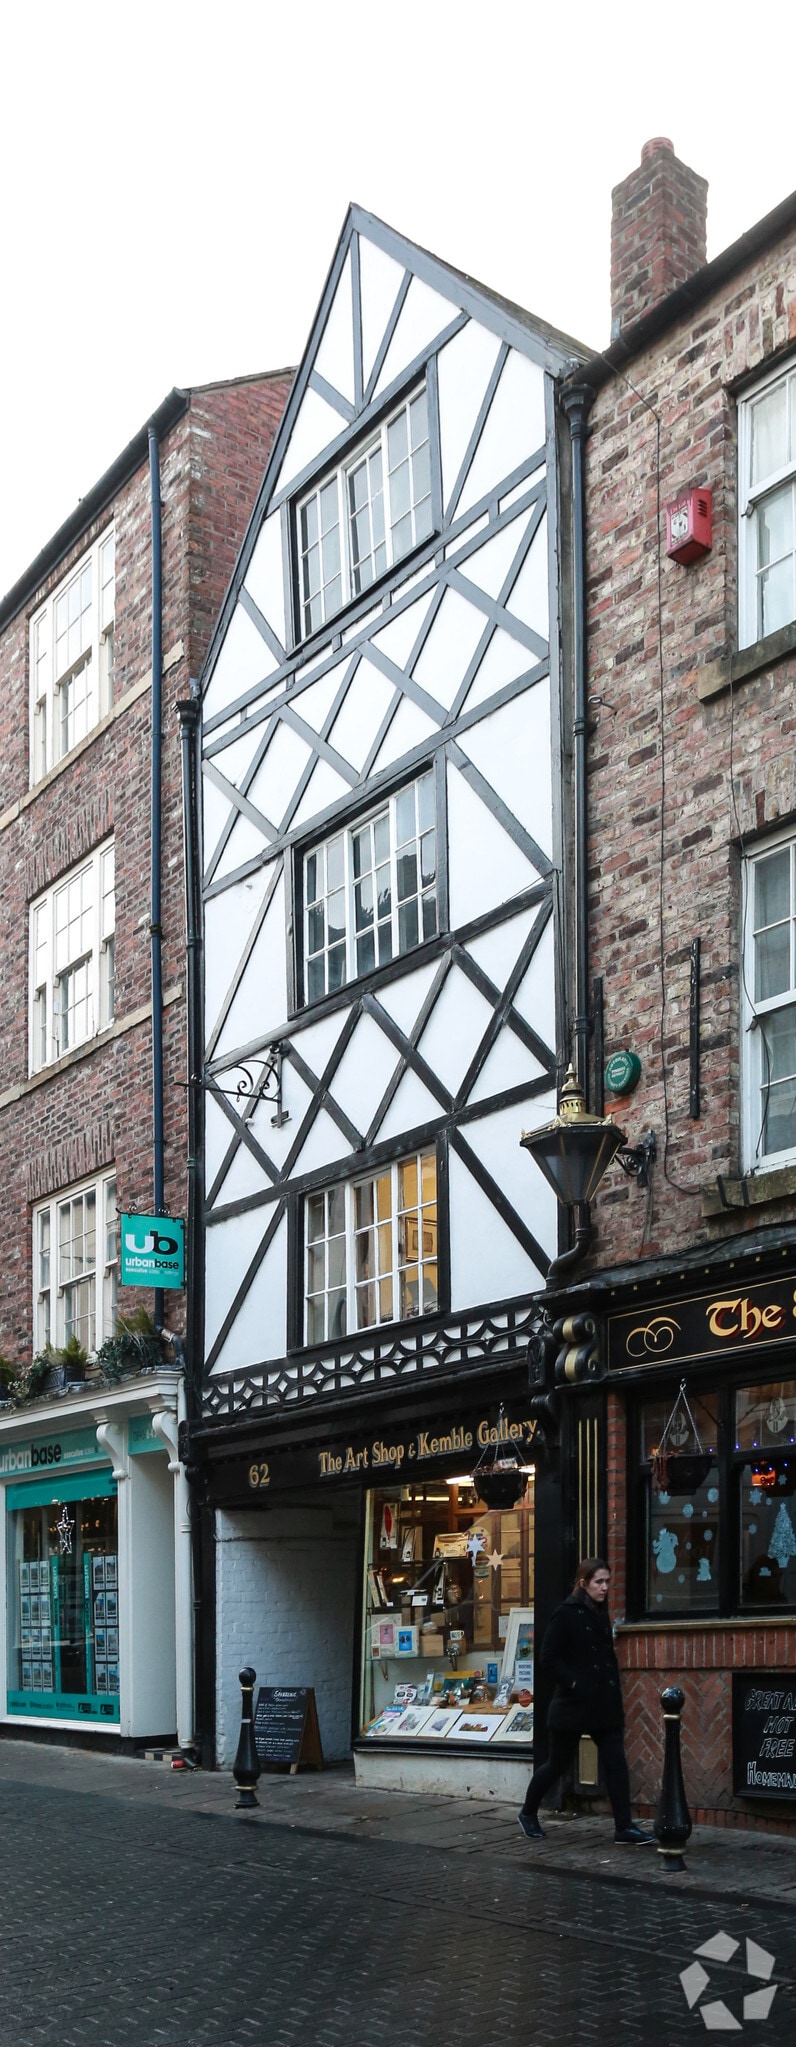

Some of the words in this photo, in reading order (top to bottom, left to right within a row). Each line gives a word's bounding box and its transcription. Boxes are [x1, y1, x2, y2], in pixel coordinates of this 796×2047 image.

[125, 1230, 179, 1255] ub
[125, 1256, 179, 1270] urbanbase
[706, 1298, 783, 1339] The
[319, 1451, 343, 1475] The
[344, 1447, 369, 1472] Art
[372, 1441, 405, 1468] Shop
[417, 1426, 473, 1458] Kemble
[249, 1464, 271, 1488] 62
[745, 1688, 784, 1711] GREAT
[763, 1715, 795, 1734] HOT
[759, 1737, 795, 1758] FREE
